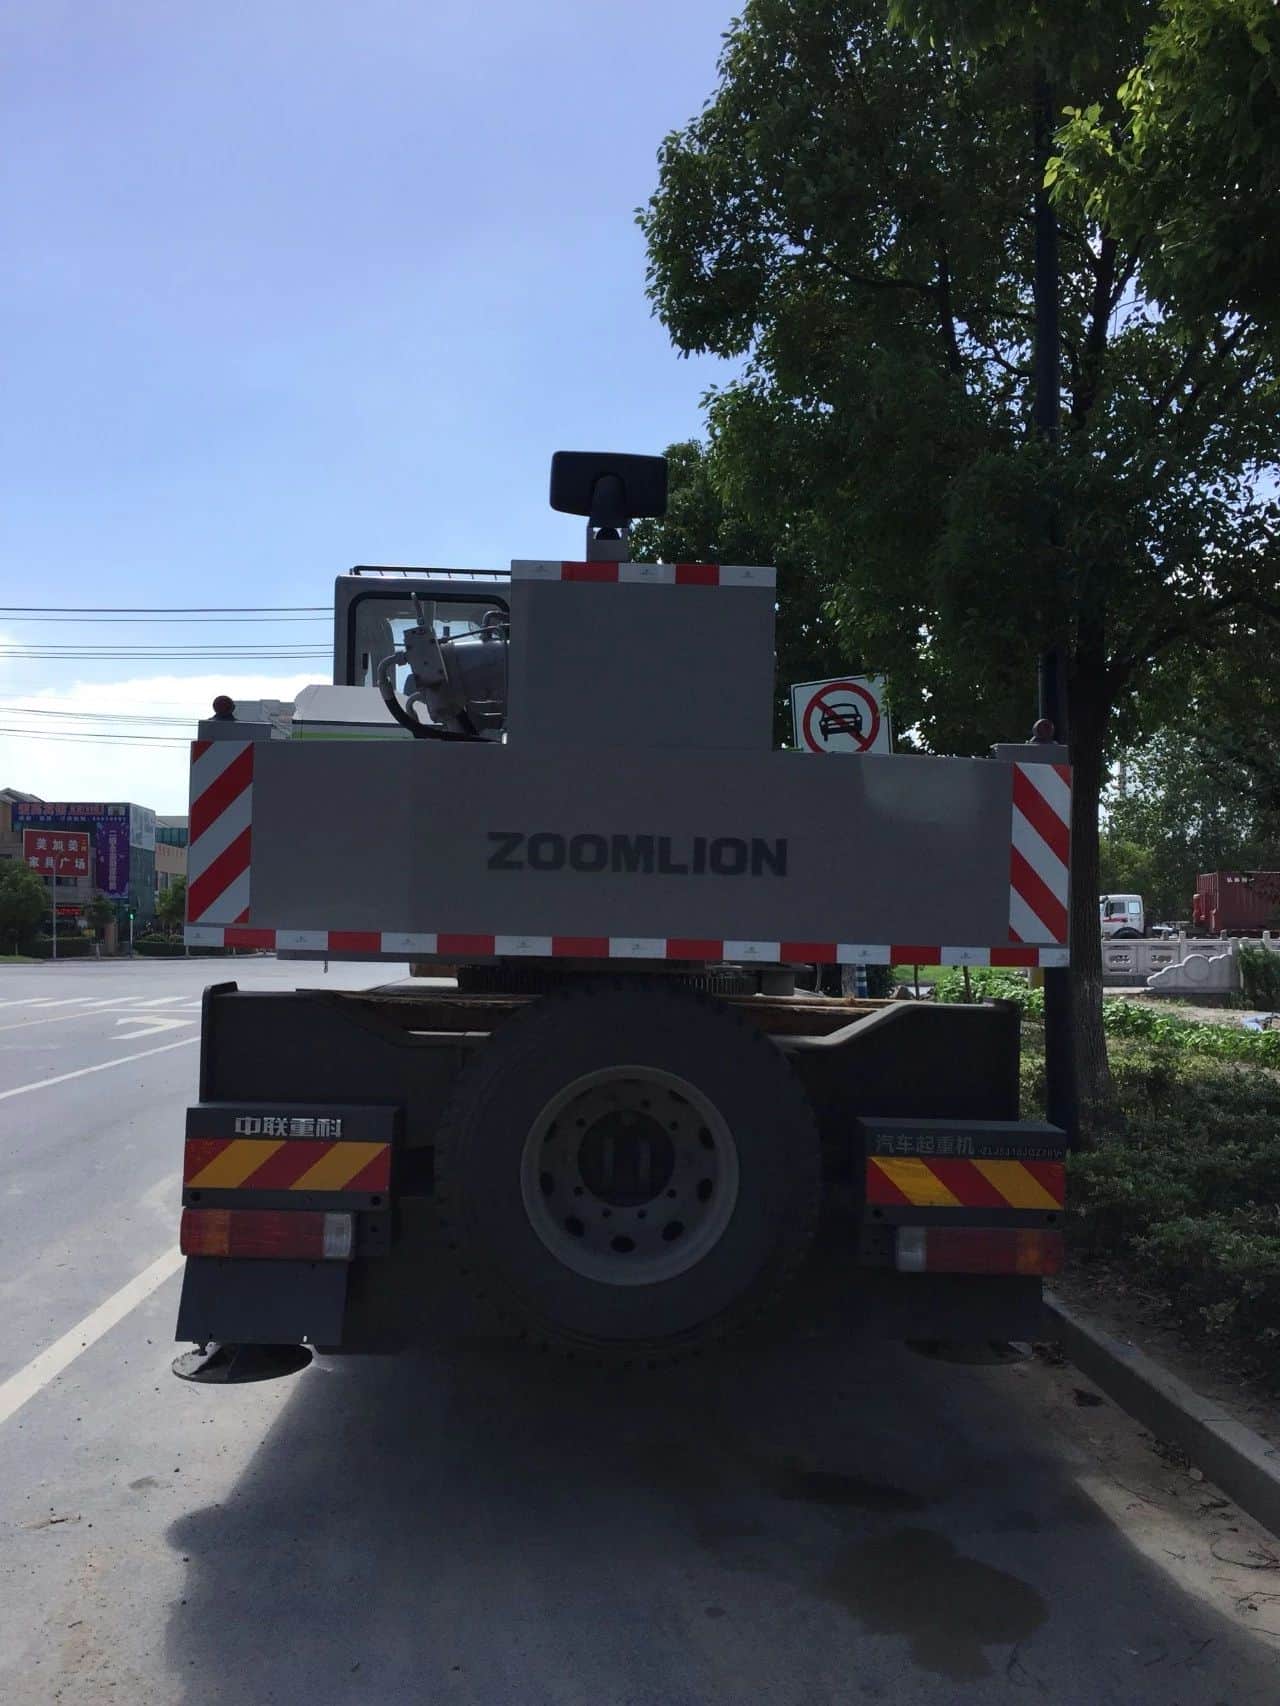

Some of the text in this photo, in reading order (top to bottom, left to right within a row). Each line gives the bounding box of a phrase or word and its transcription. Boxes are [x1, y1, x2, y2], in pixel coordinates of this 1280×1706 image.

[28, 855, 85, 870] 家具广场
[487, 831, 788, 877] ZOOMLION
[234, 1116, 343, 1138] 中联重科
[875, 1134, 974, 1155] 汽车起重机
